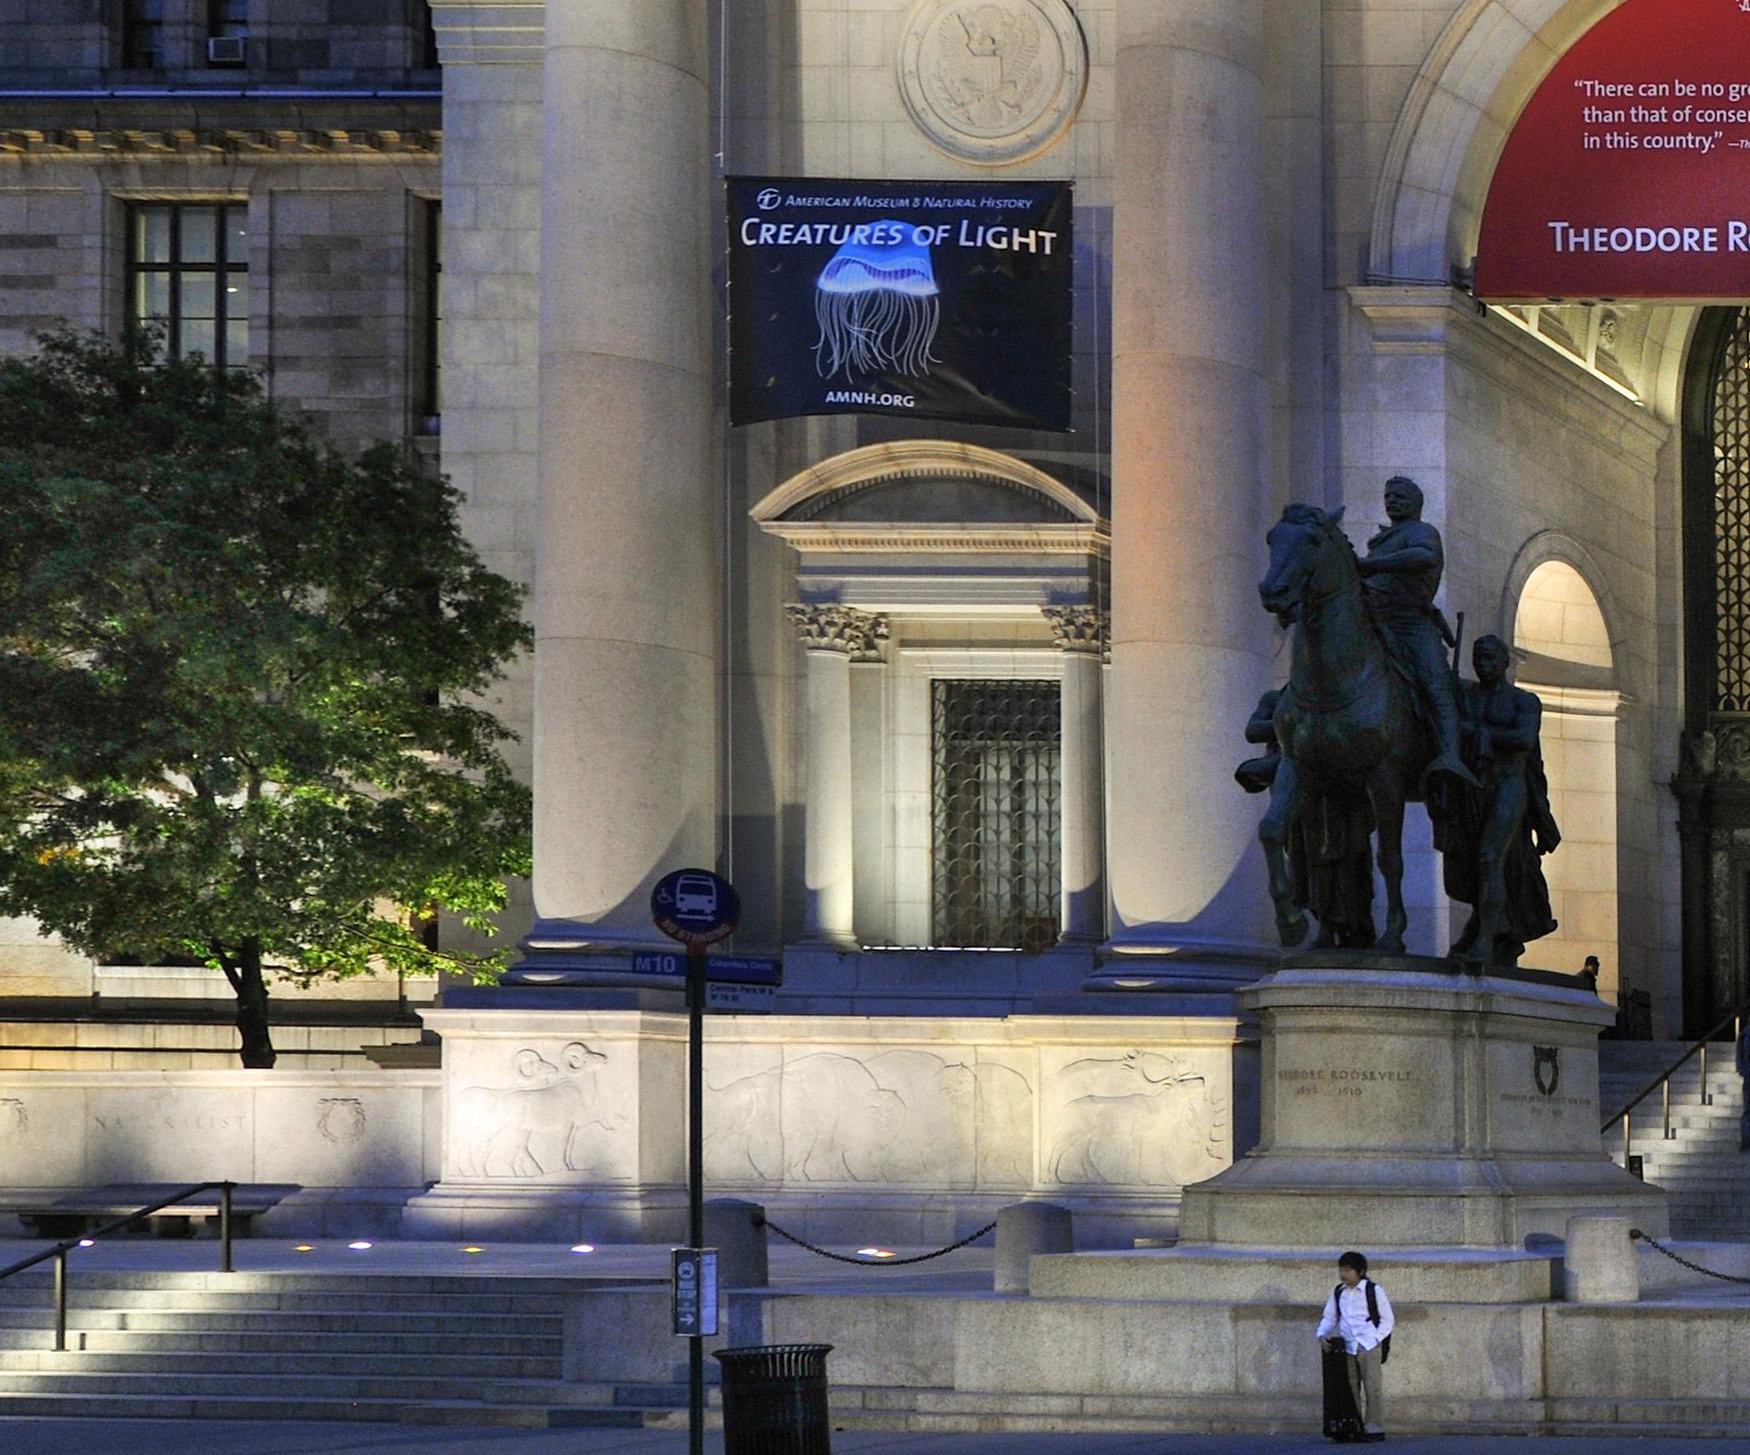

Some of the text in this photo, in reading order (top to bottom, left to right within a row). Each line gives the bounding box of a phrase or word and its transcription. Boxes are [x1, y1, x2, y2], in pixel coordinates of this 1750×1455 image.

[1574, 80, 1634, 97] “There
[1638, 84, 1670, 97] can
[1675, 79, 1697, 96] be
[1701, 84, 1724, 97] no
[1583, 106, 1625, 123] than
[1629, 106, 1668, 123] that
[1672, 105, 1693, 123] of
[1583, 132, 1600, 149] in
[1604, 131, 1639, 149] this
[1643, 131, 1723, 154] country.”
[785, 194, 850, 207] AMERICAN
[853, 195, 910, 208] MUSEUM
[923, 196, 977, 209] NATURAL
[980, 197, 1033, 210] HISTORY
[741, 218, 1057, 255] CREATURES OF LIGHT
[1548, 221, 1718, 253] THEODORE
[825, 391, 915, 408] AMNH.ORG
[635, 956, 677, 974] M10
[1330, 1069, 1412, 1082] ROOSEVELT
